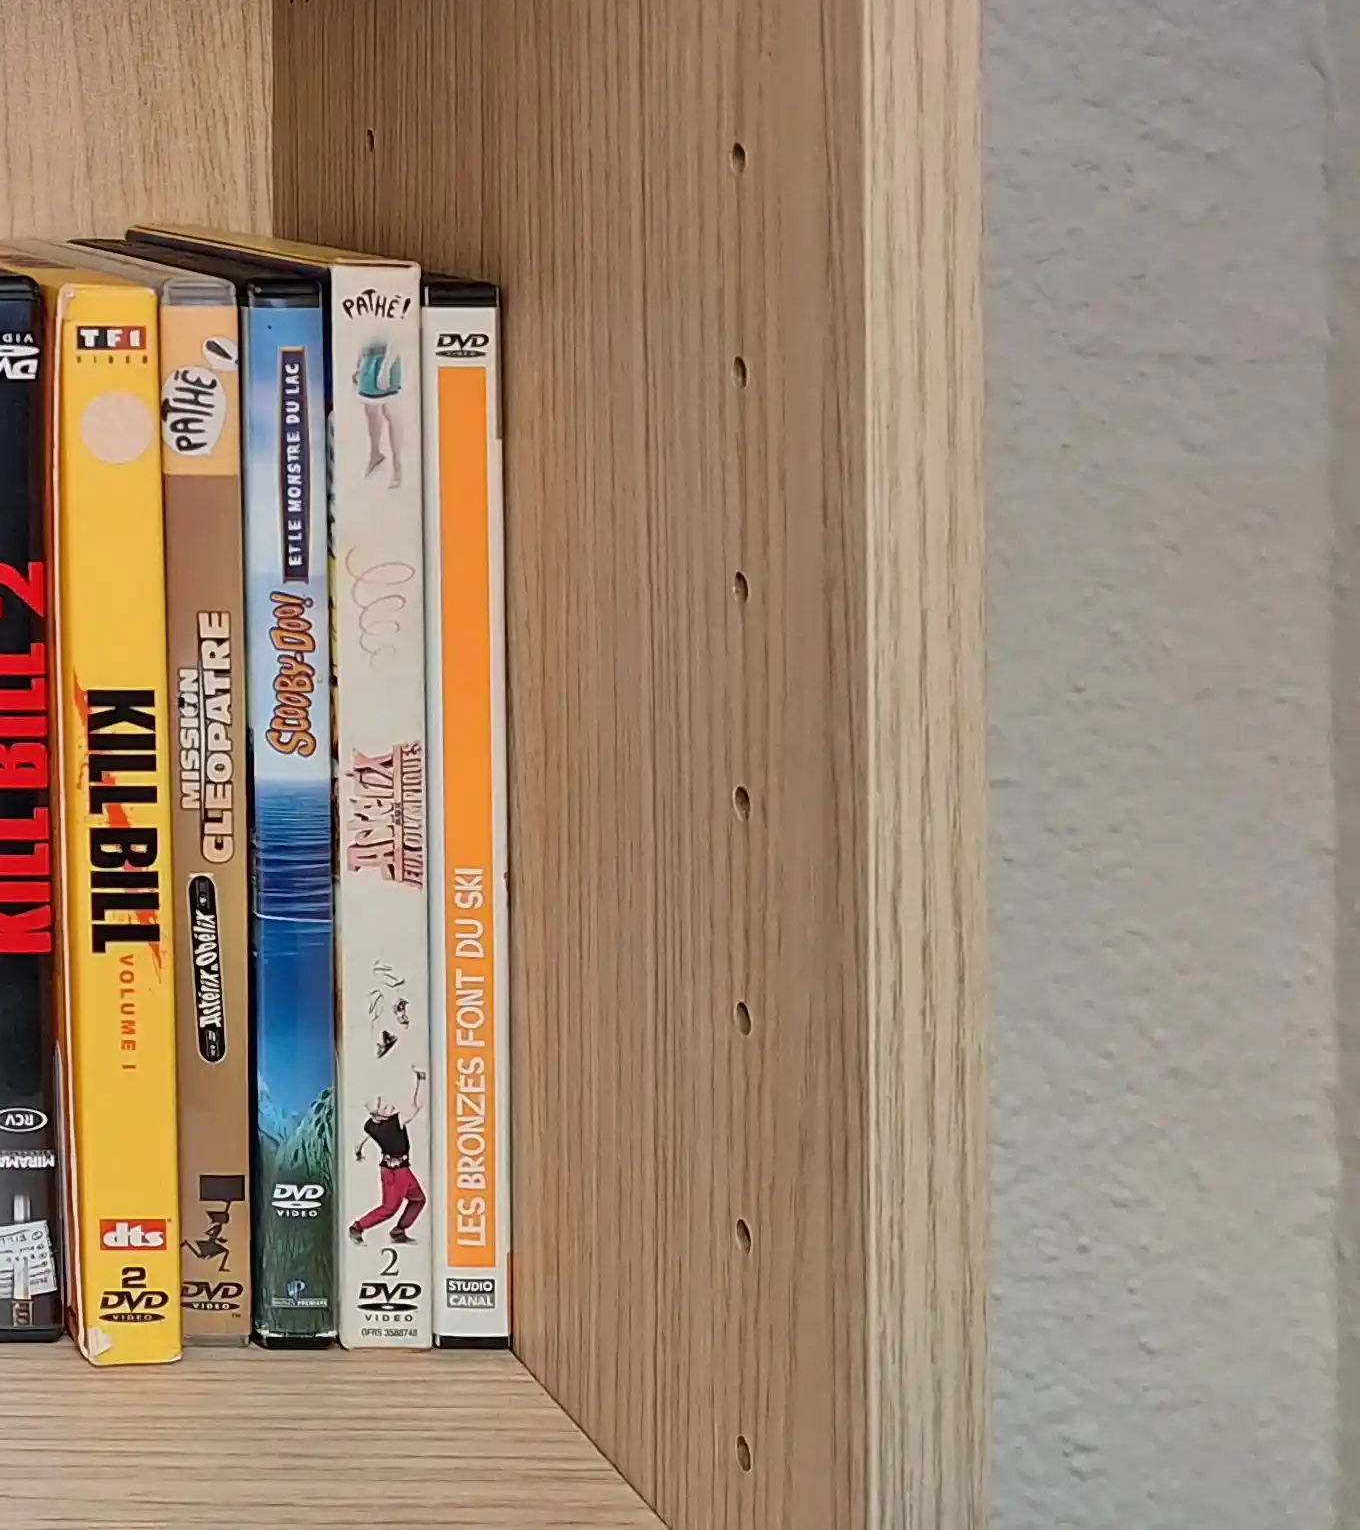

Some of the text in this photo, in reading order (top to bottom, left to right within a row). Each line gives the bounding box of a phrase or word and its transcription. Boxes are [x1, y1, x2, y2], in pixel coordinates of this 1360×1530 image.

[79, 328, 141, 348] TF1
[436, 333, 490, 349] DVD
[283, 362, 303, 566] ET LE MONSTRE DU LAC
[263, 589, 317, 757] SCOOBY-DOO!
[178, 668, 201, 811] MISSION
[199, 611, 236, 865] CLEOPATRE
[87, 688, 161, 1051] KILL BILL VOLUME
[193, 909, 222, 1029] Astérix Obélix
[454, 867, 486, 1247] LES BRONZÉS FONT DU SKI
[101, 1222, 165, 1248] dts
[99, 1291, 170, 1312] DVD
[121, 1266, 147, 1289] 2
[448, 1280, 494, 1293] STUDIO
[448, 1295, 494, 1307] CANAL
